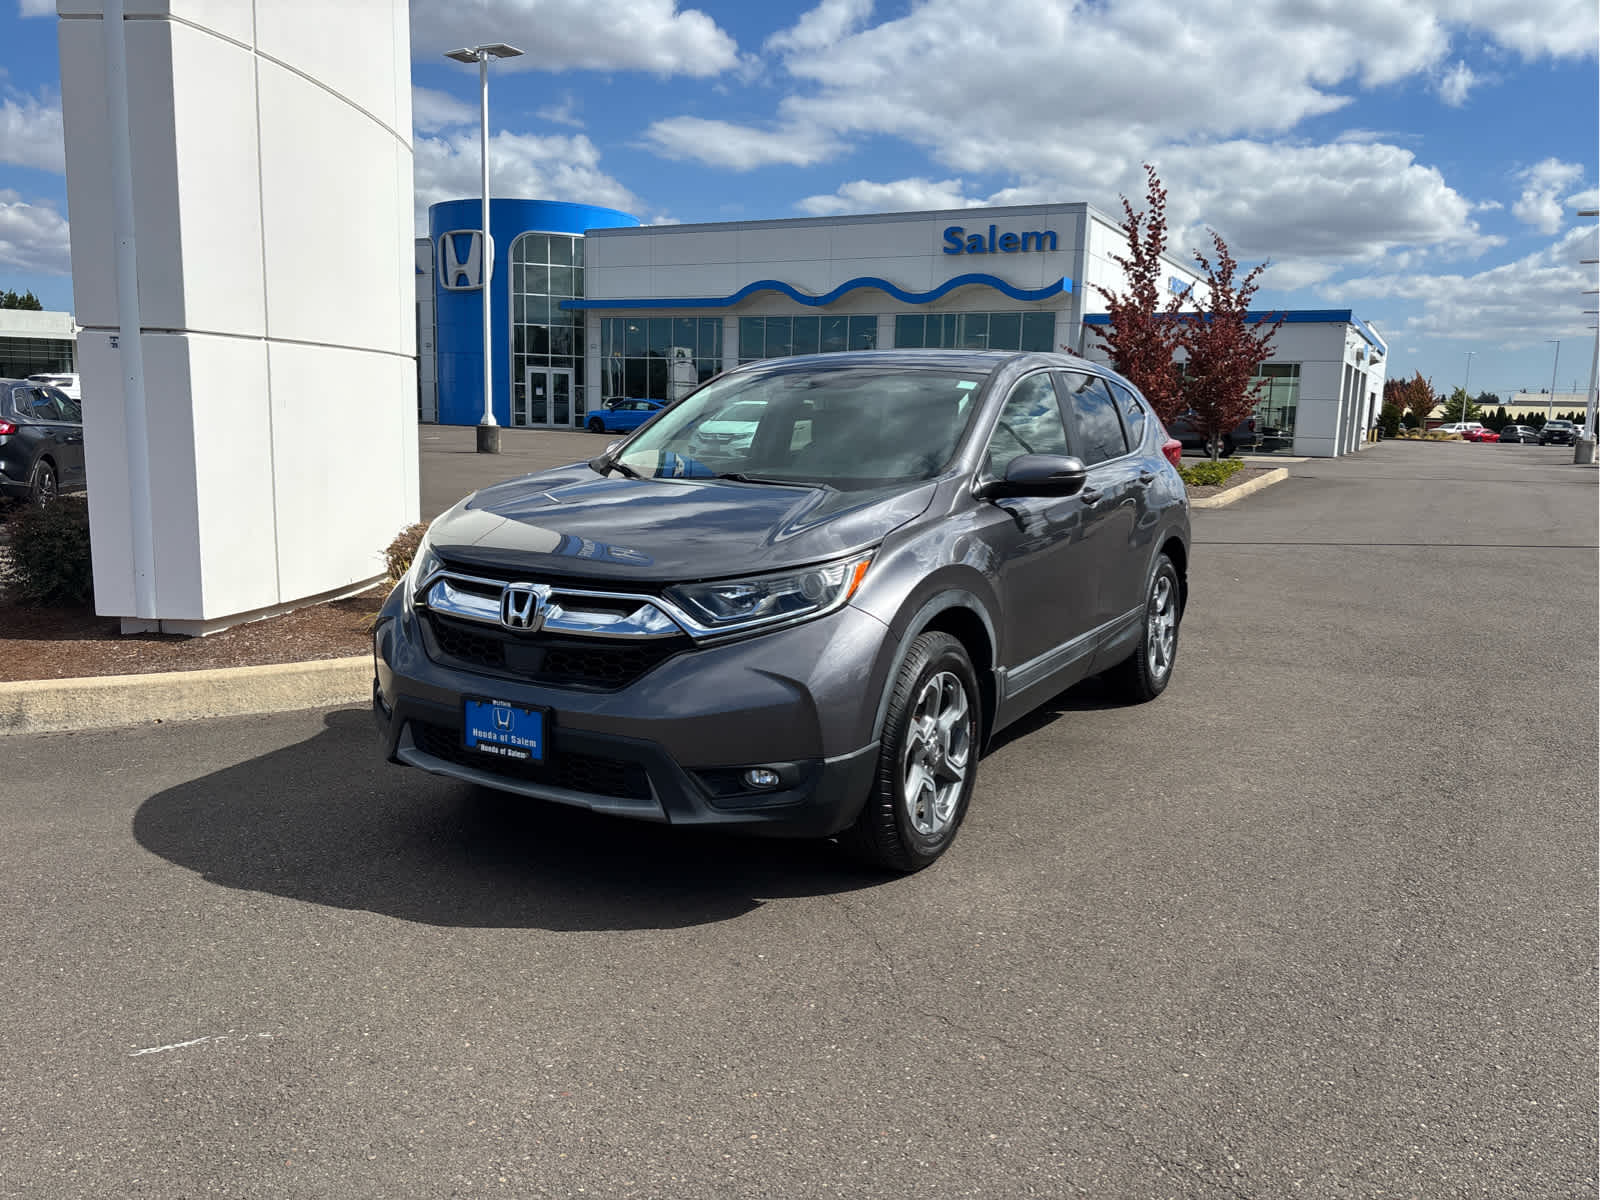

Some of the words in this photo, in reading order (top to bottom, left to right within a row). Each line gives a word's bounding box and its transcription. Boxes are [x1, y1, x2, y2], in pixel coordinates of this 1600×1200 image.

[943, 224, 1057, 254] Salem
[472, 728, 497, 740] Honda
[500, 734, 508, 743] of
[511, 735, 537, 748] Salem
[480, 743, 499, 754] Honda
[500, 747, 507, 756] of
[507, 748, 528, 759] Salem
